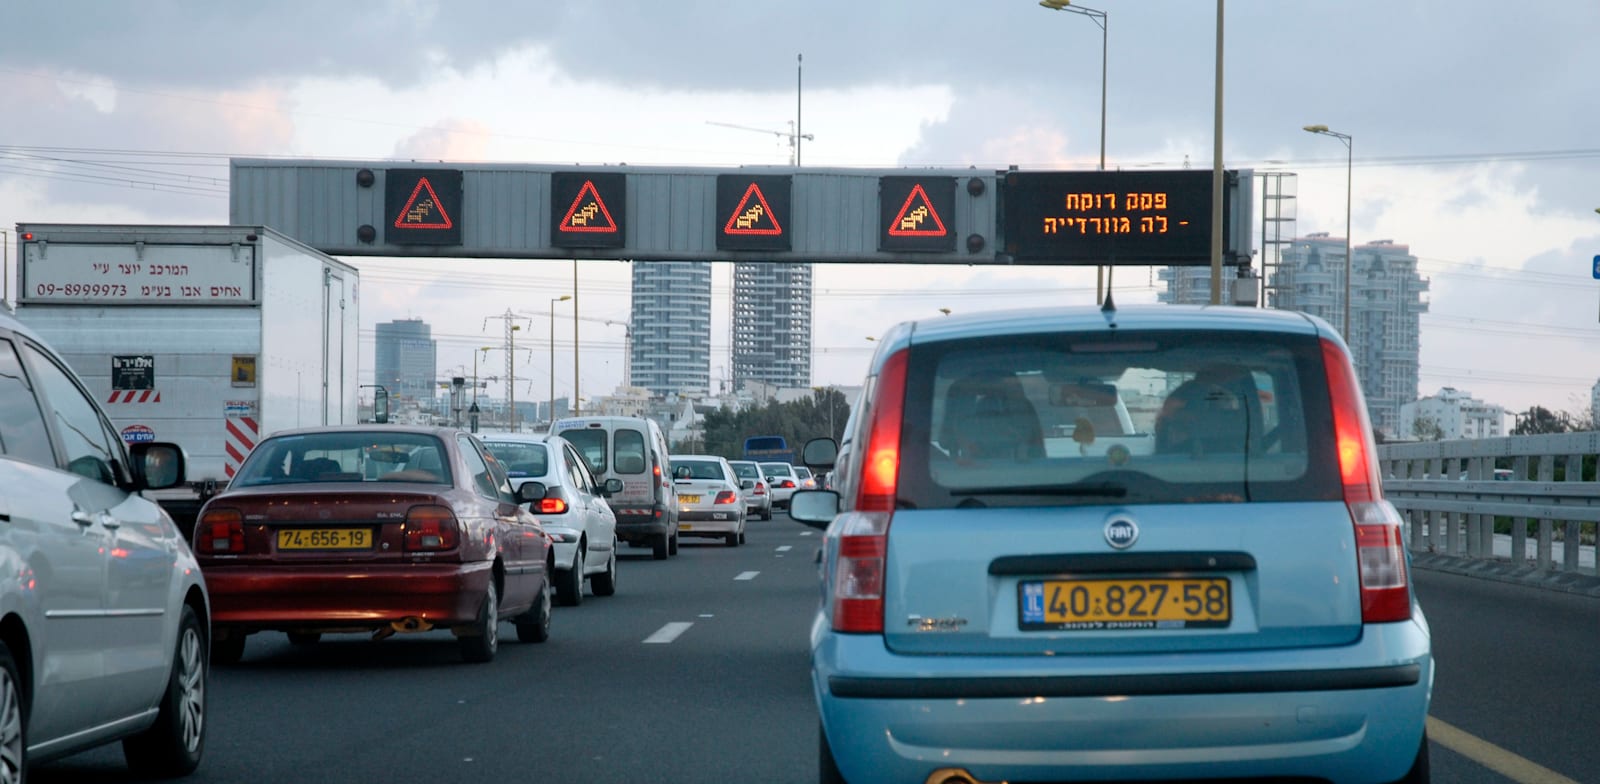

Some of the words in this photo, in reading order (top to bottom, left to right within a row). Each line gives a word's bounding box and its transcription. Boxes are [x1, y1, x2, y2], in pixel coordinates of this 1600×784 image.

[1066, 193, 1116, 211] רוקח
[1126, 192, 1167, 211] פקק
[1044, 216, 1131, 234] גוורדייה
[1141, 215, 1168, 233] לה
[118, 263, 141, 275] יוצר
[150, 263, 188, 276] המרכב
[37, 283, 128, 297] 09-8999973
[181, 284, 201, 297] אבו
[210, 285, 242, 297] אחים
[283, 530, 365, 547] 74-656-19
[1110, 525, 1132, 539] FIAT
